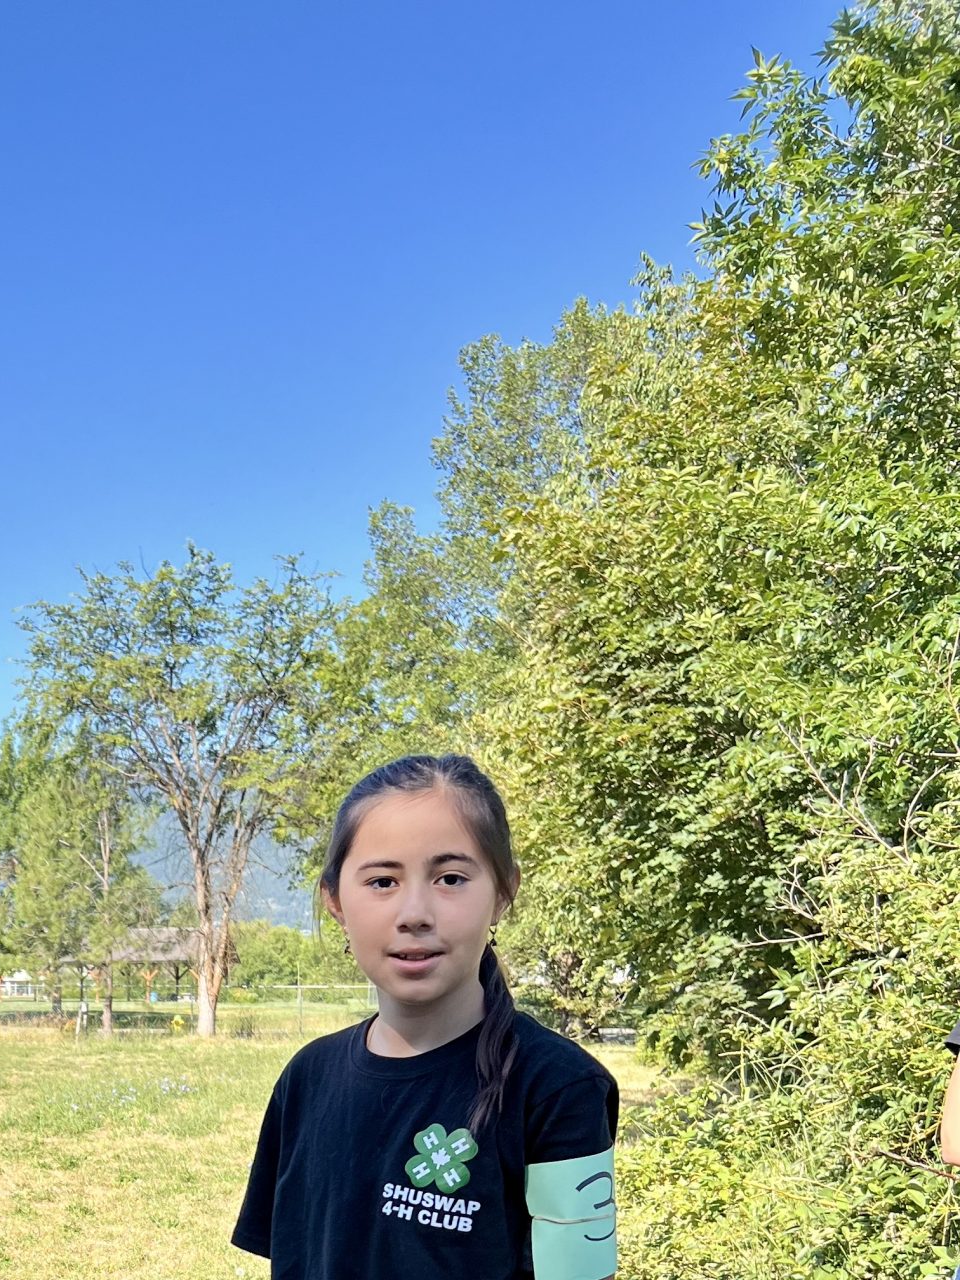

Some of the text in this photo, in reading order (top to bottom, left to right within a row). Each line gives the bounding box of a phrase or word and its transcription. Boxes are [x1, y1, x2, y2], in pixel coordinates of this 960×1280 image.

[423, 1131, 439, 1149] H
[451, 1137, 470, 1155] H
[412, 1162, 430, 1179] H
[442, 1168, 461, 1187] H
[382, 1182, 481, 1215] SHUSWAP
[575, 1171, 617, 1241] 3
[381, 1200, 473, 1232] 4-H CLUB
